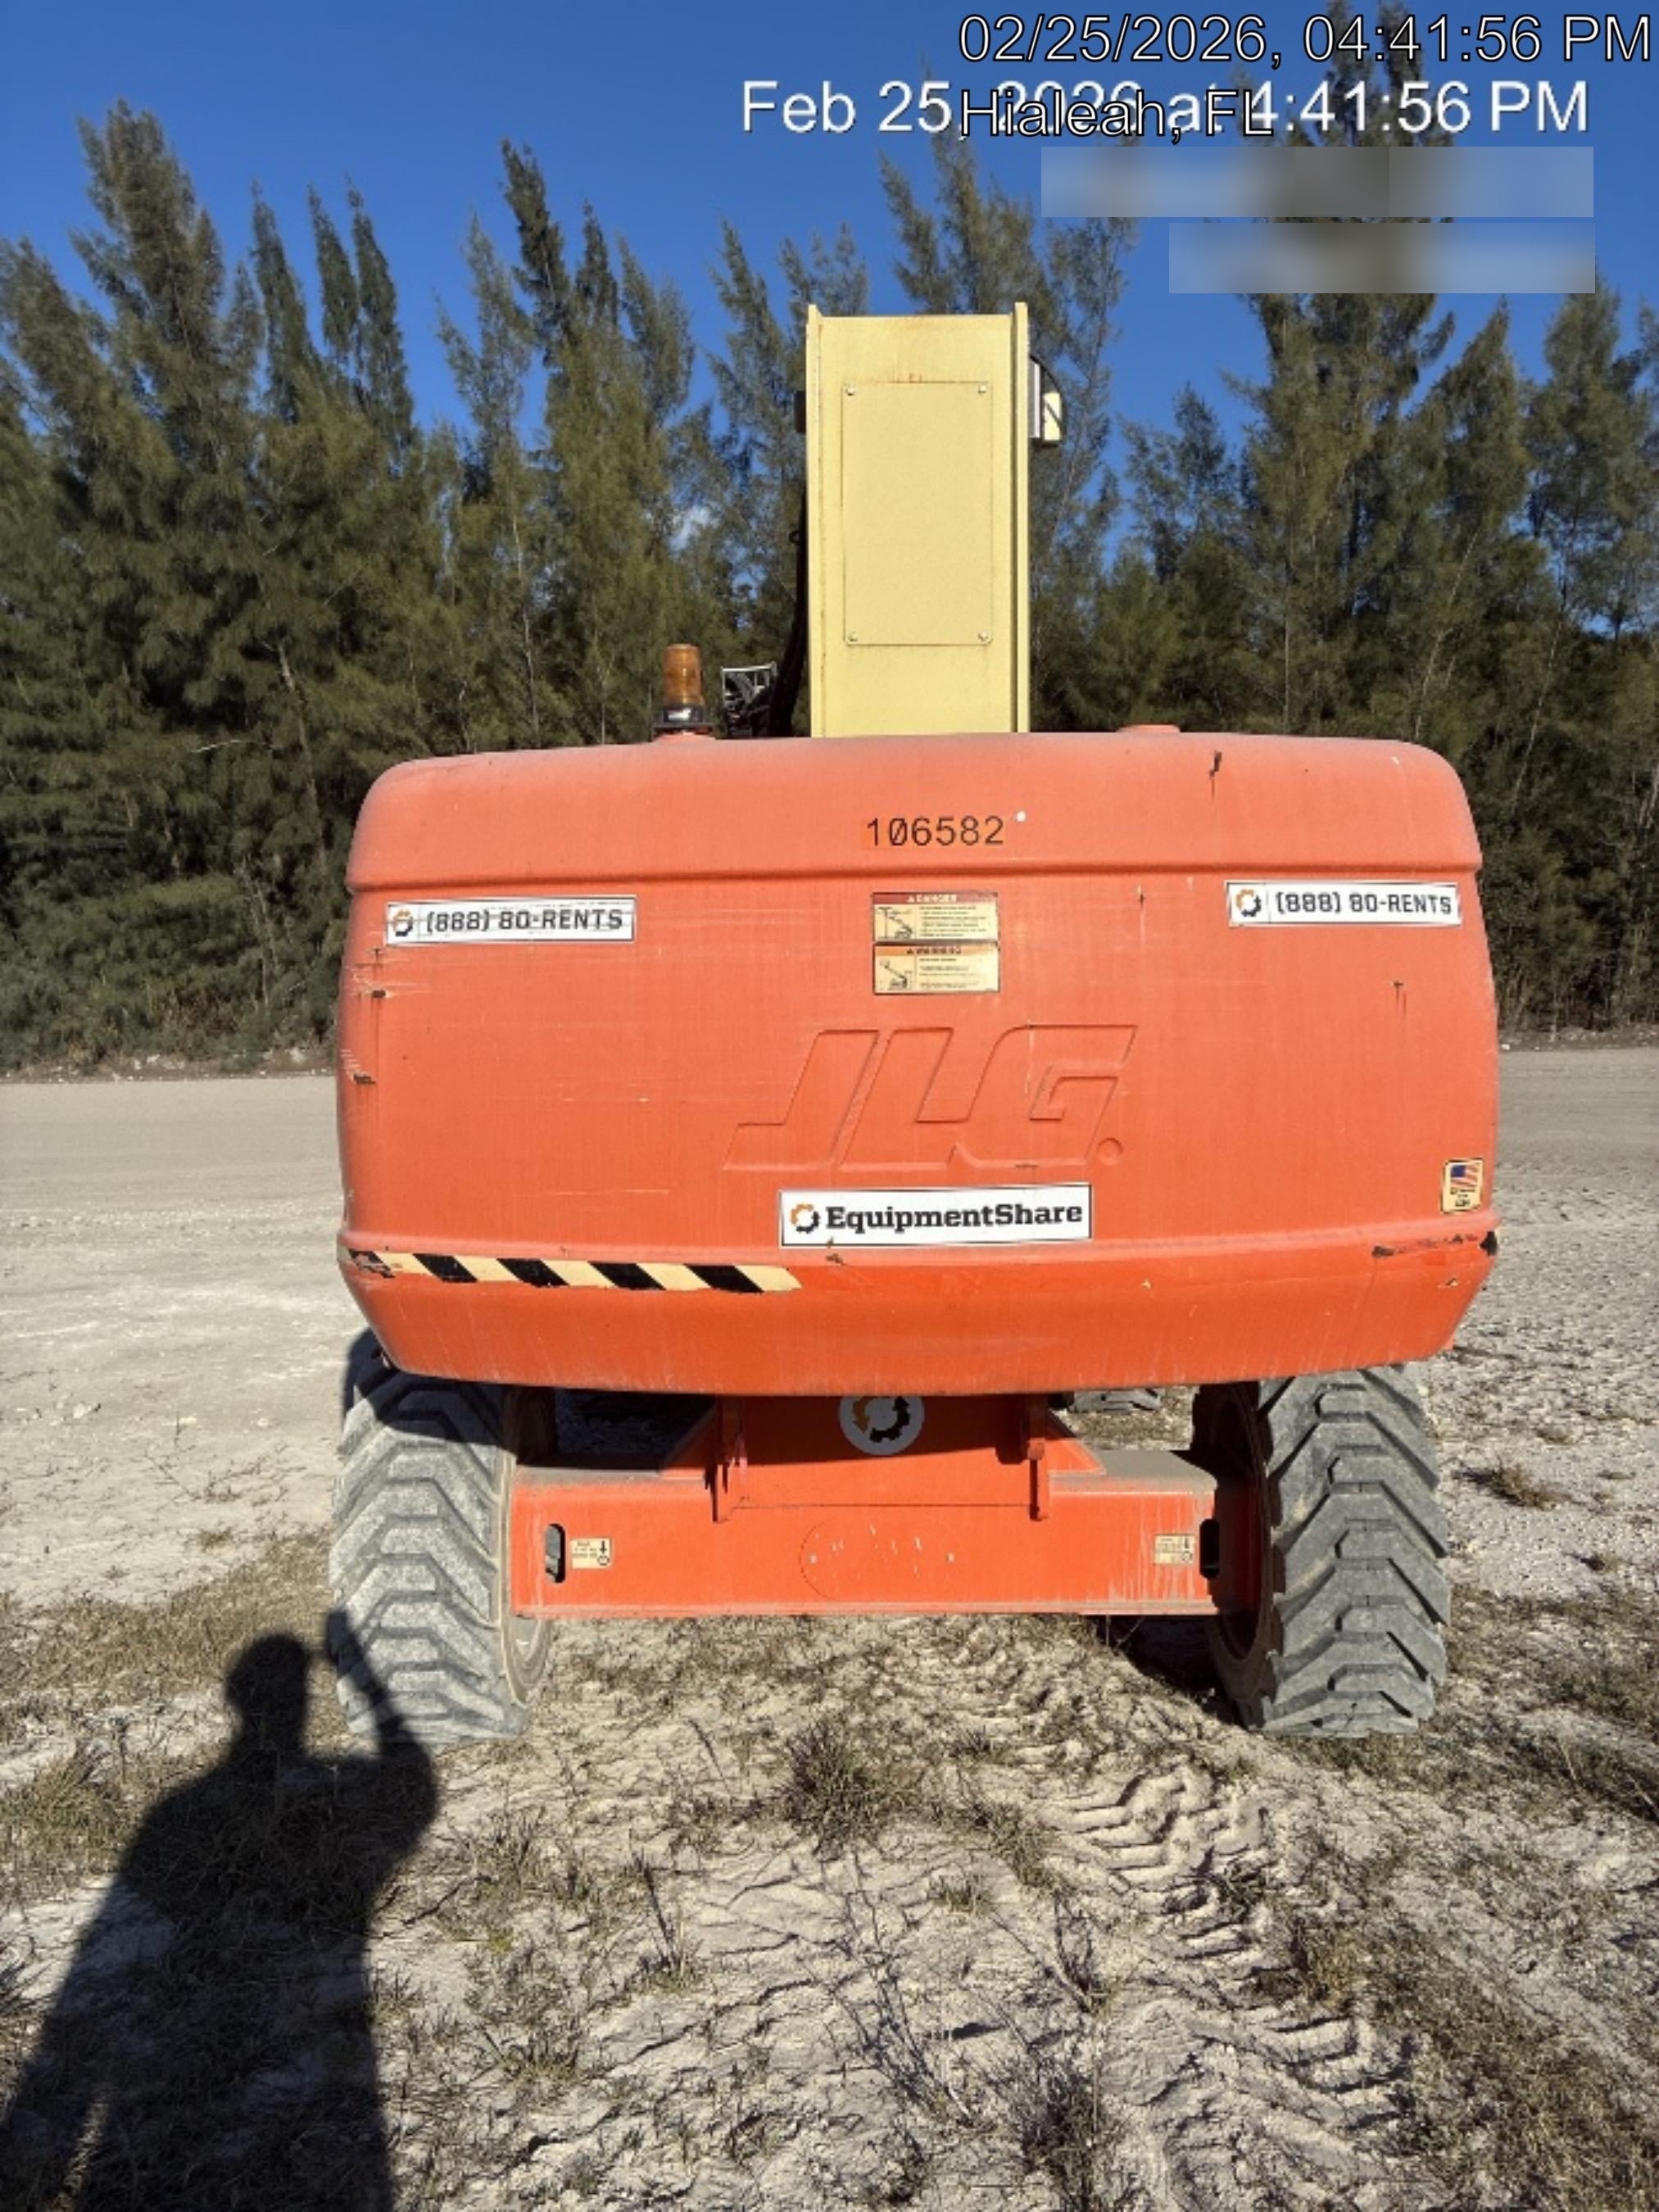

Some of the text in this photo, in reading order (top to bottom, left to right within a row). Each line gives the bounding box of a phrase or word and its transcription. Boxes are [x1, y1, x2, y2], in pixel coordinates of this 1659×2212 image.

[867, 815, 1004, 847] 106582
[1276, 891, 1452, 914] (888) 80-RENTS
[426, 909, 623, 934] (888) 80-RENTS
[825, 1203, 1083, 1235] EquipmentShare
